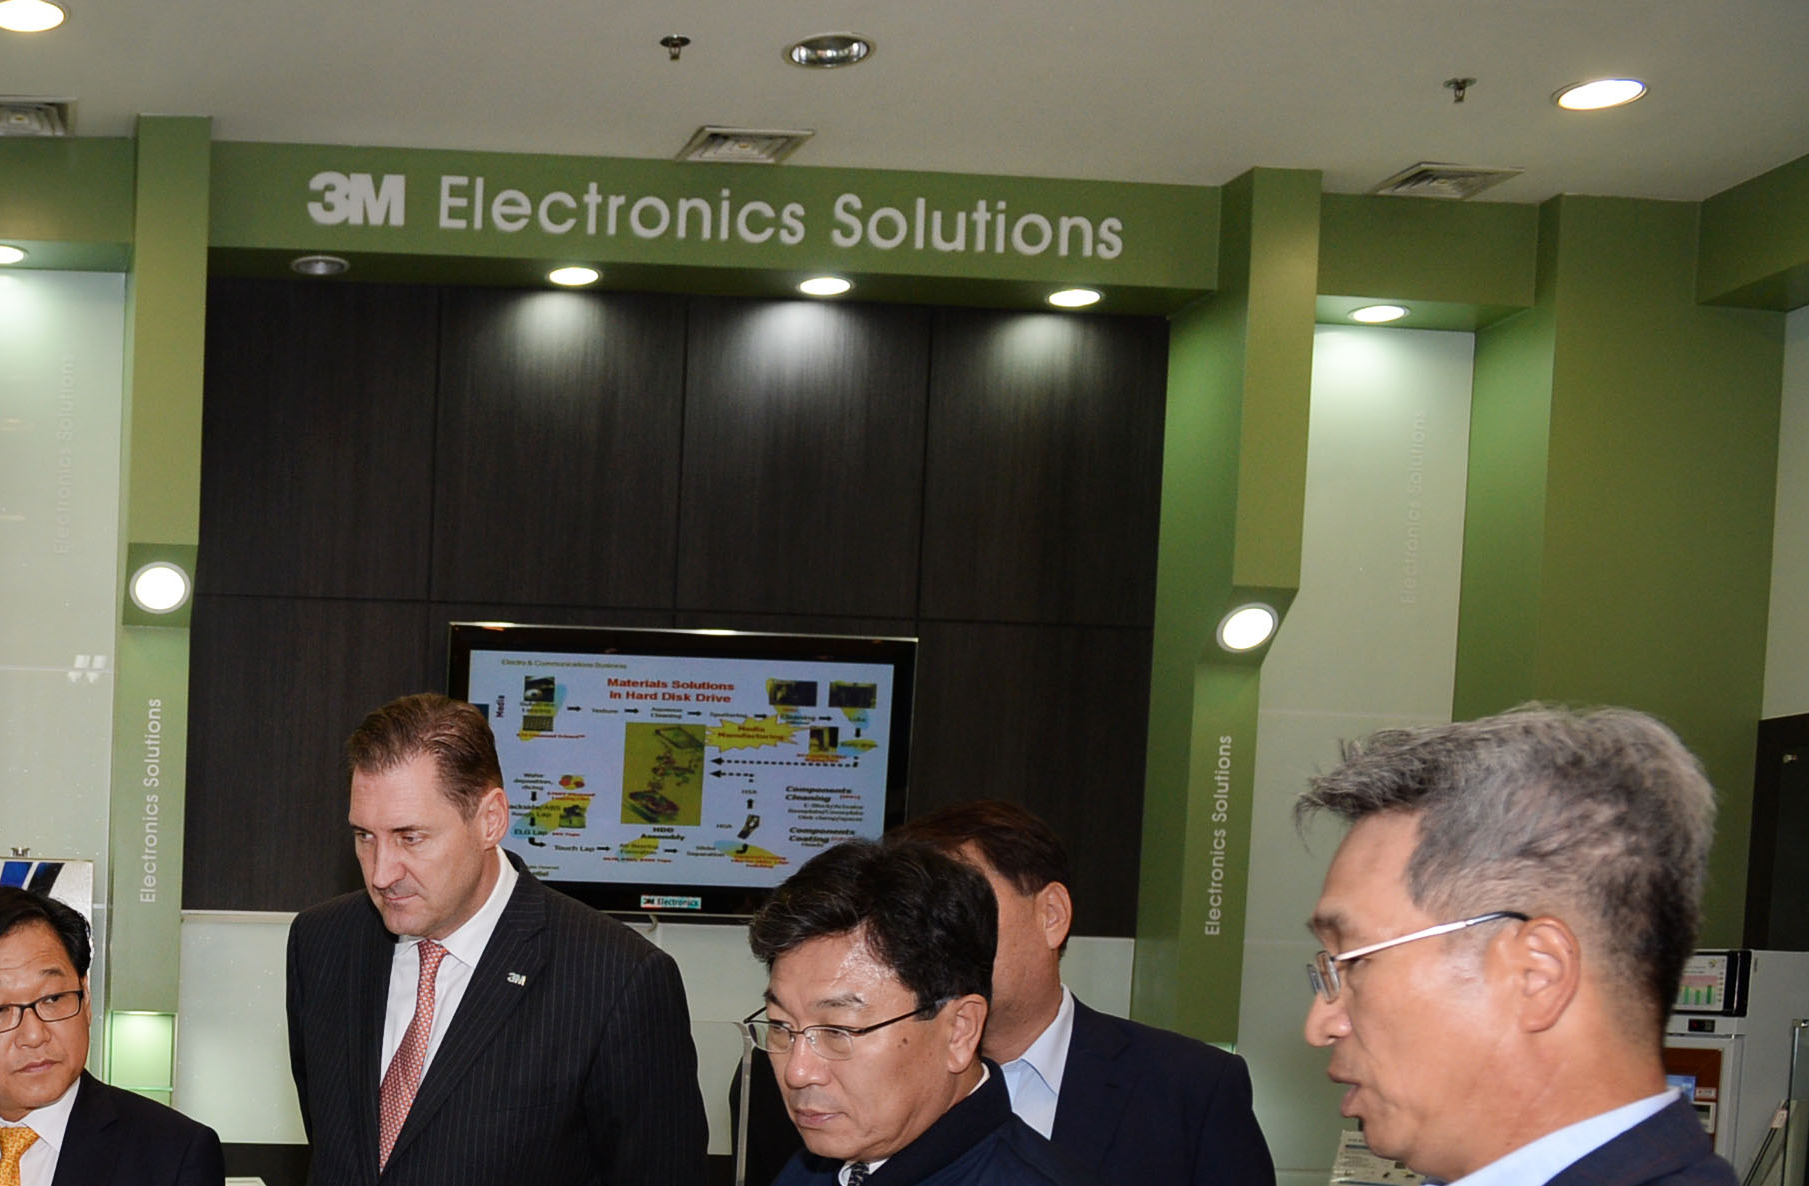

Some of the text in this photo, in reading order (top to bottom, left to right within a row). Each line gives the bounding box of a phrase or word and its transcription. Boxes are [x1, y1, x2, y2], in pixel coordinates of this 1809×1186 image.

[307, 171, 1124, 260] 3M Electronics Solutions
[607, 678, 735, 691] Materials Solutions
[625, 690, 658, 701] Hard
[661, 692, 691, 702] Disk
[696, 692, 731, 703] Drive
[140, 699, 161, 902] Electronics Solutions
[1205, 735, 1232, 935] Electronics Solutions
[657, 897, 699, 907] Electronics
[506, 971, 527, 986] 3M
